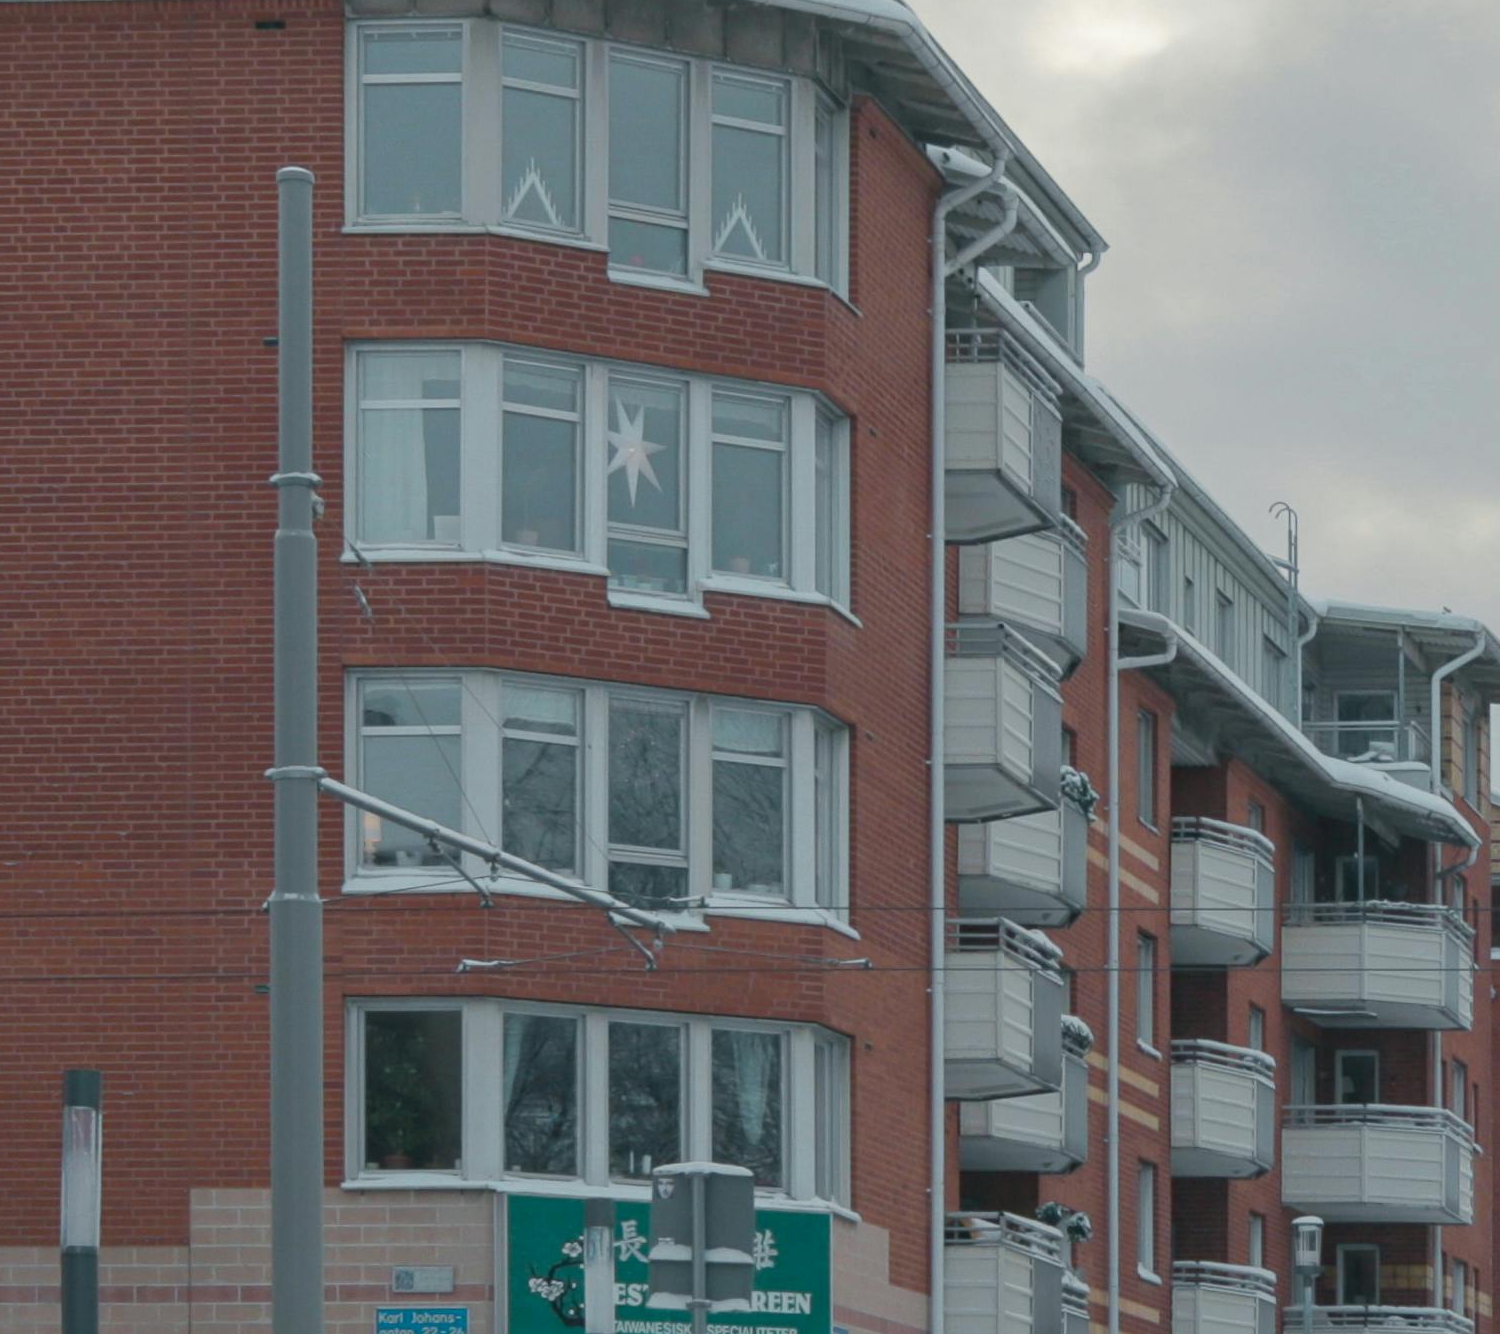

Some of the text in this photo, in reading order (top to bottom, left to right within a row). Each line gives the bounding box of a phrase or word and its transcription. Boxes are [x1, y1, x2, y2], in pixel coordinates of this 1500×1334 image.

[613, 1283, 812, 1315] ES REEN
[379, 1312, 462, 1324] Karl Johans-
